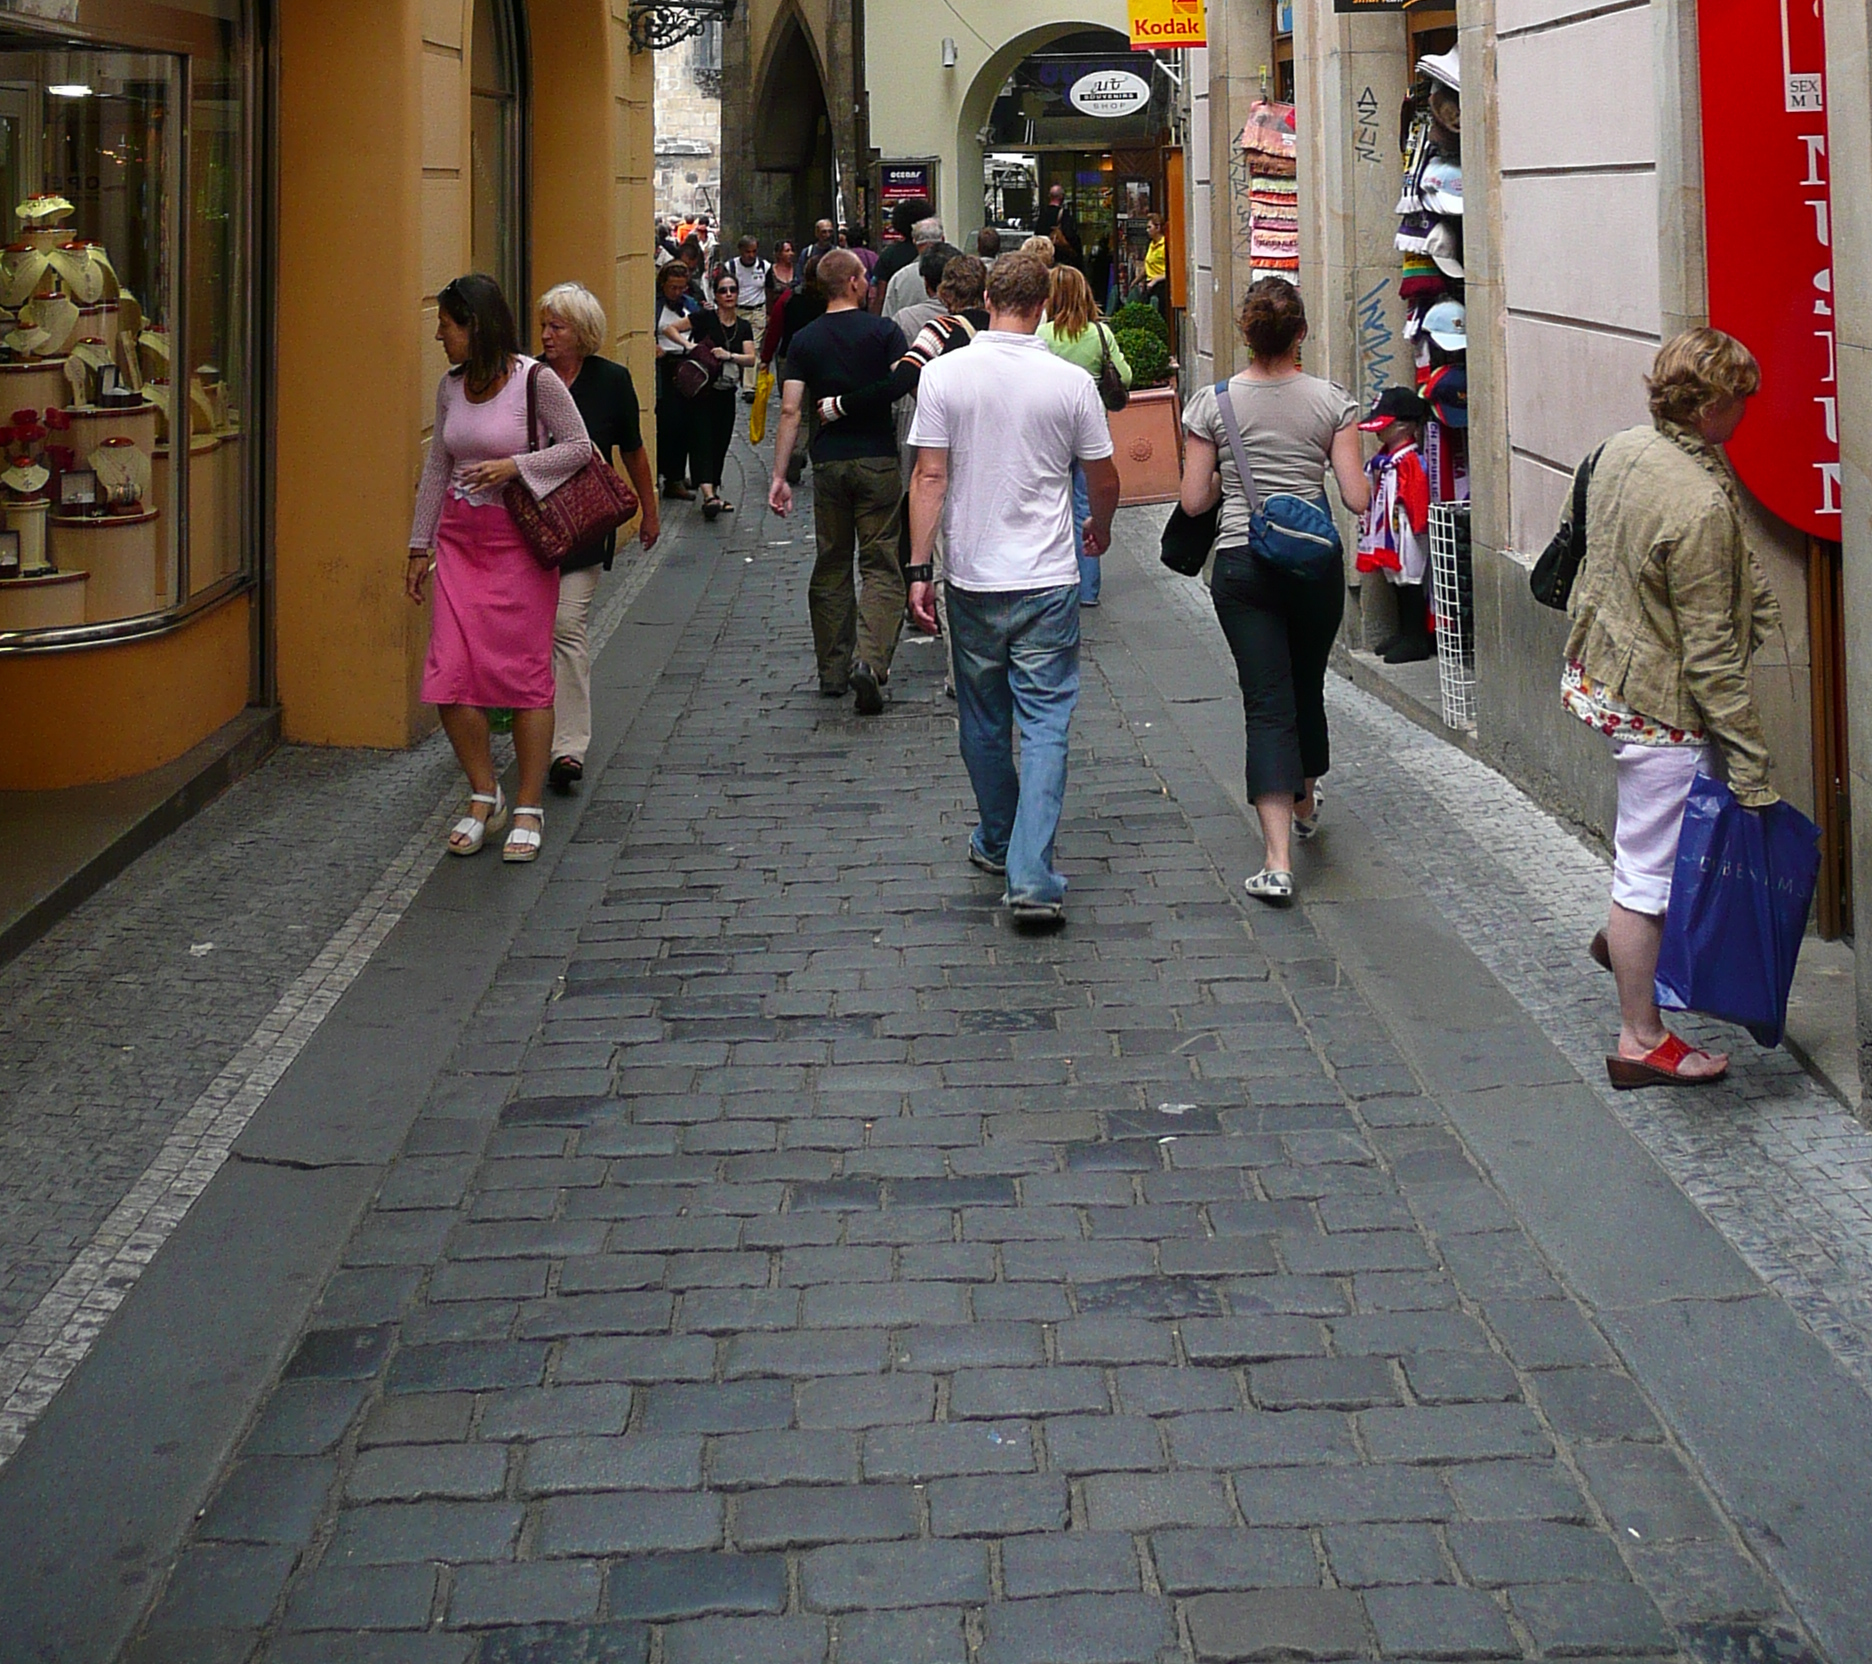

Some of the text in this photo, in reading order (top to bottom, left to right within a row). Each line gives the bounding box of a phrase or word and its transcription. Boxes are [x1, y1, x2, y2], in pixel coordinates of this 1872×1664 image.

[1134, 17, 1200, 36] Kodak
[1789, 79, 1819, 93] SEX
[1093, 102, 1126, 110] SHOP
